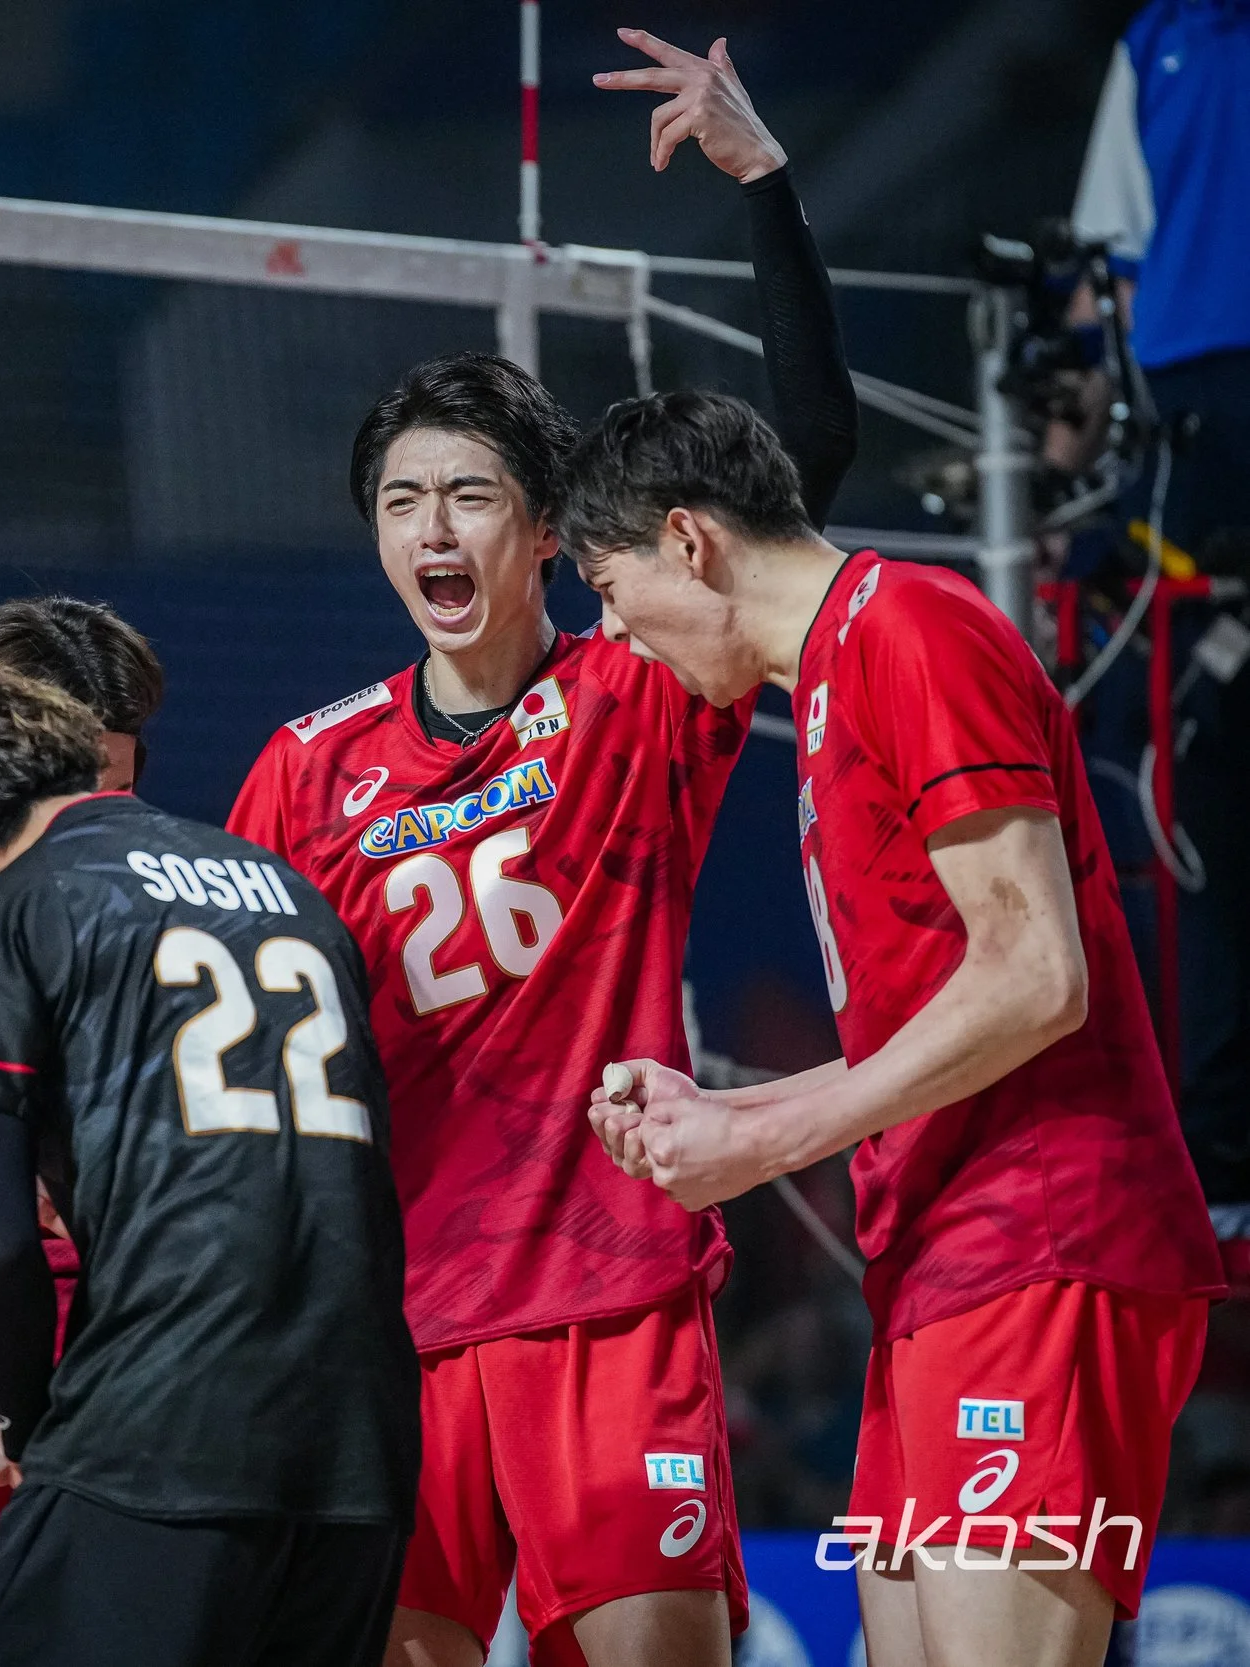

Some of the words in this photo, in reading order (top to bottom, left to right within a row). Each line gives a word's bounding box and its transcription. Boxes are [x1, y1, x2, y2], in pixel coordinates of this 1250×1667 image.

[526, 718, 560, 742] JPN
[358, 757, 557, 860] CAPCOM
[126, 850, 299, 916] SOSHI
[384, 825, 565, 1017] 26
[153, 926, 373, 1145] 22
[961, 1405, 1021, 1434] TEL
[648, 1458, 704, 1485] TEL
